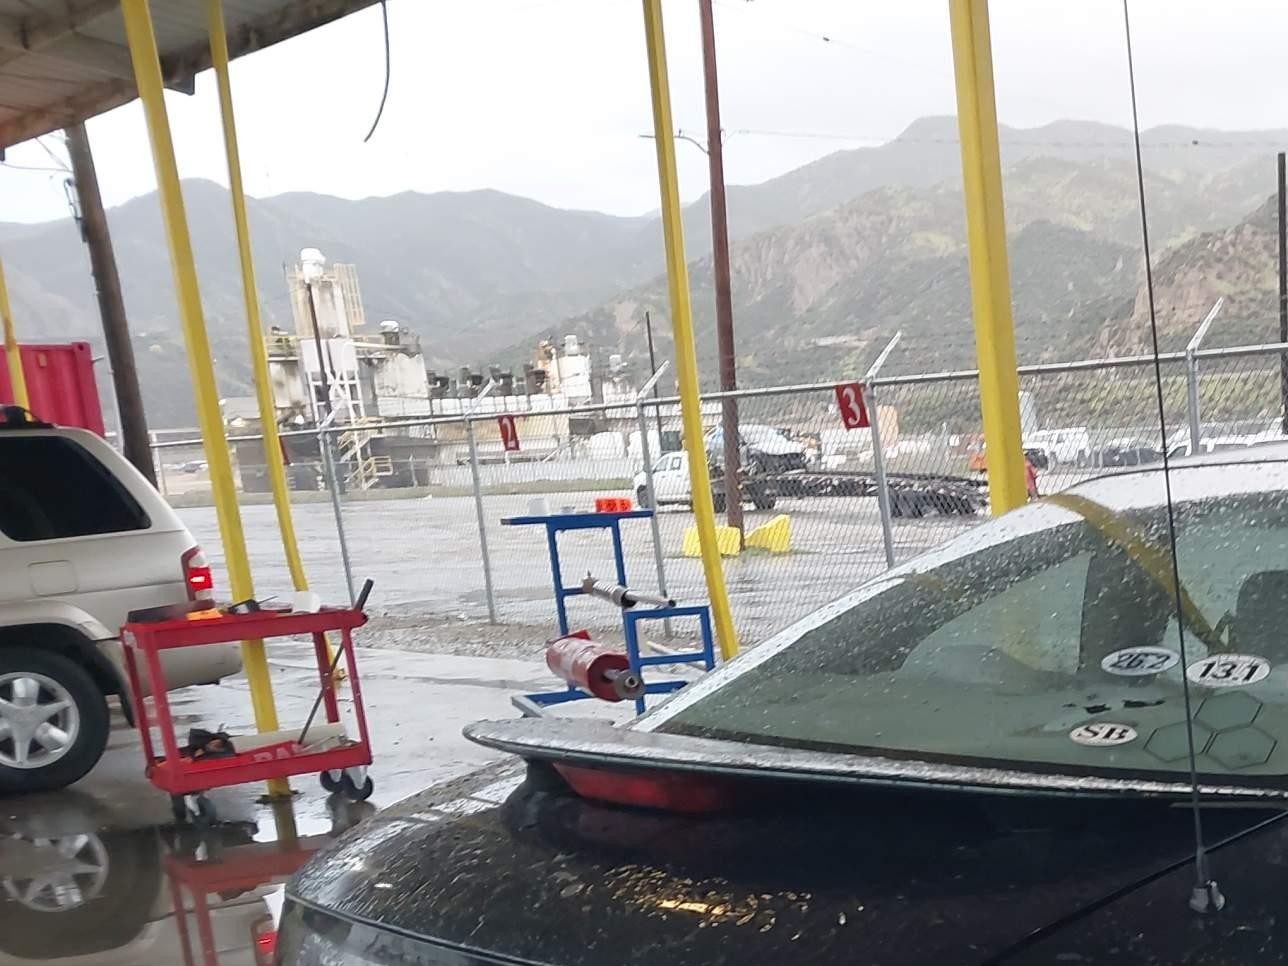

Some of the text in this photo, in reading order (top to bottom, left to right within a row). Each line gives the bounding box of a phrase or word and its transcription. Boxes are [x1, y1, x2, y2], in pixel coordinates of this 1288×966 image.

[842, 386, 861, 426] 3
[502, 417, 516, 448] 2
[1109, 651, 1171, 669] 26.2
[1199, 660, 1260, 682] 13.1
